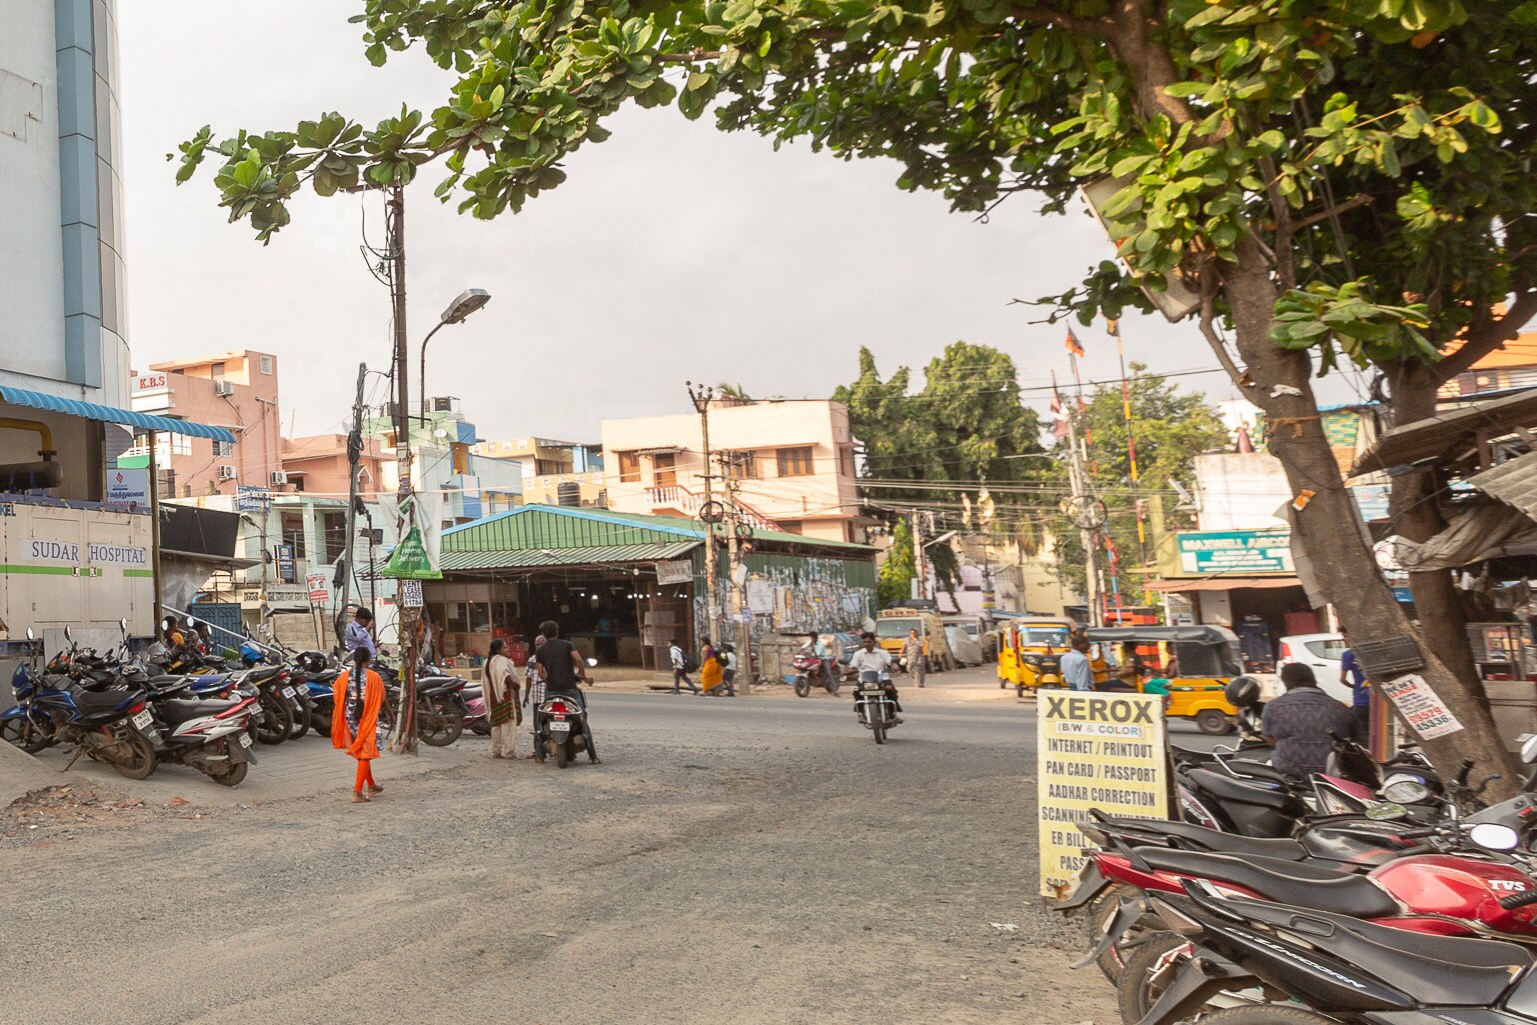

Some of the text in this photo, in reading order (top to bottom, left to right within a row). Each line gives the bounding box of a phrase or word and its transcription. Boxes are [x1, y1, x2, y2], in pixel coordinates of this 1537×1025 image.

[32, 541, 146, 564] SUDAR HOSPITAL
[403, 580, 421, 588] RENT
[1046, 696, 1154, 724] XEROX
[1048, 738, 1093, 754] INTERNET
[1103, 742, 1153, 758] PRINTOUT
[1046, 760, 1064, 775] PAN
[1067, 762, 1094, 777] CARD
[1104, 765, 1156, 782] PASSPORT
[1049, 784, 1156, 806] AADHAR CORRECTION
[1042, 806, 1092, 824] SCANNING
[1051, 831, 1063, 845] EB
[1067, 832, 1087, 848] BILL
[1488, 879, 1526, 892] TVS
